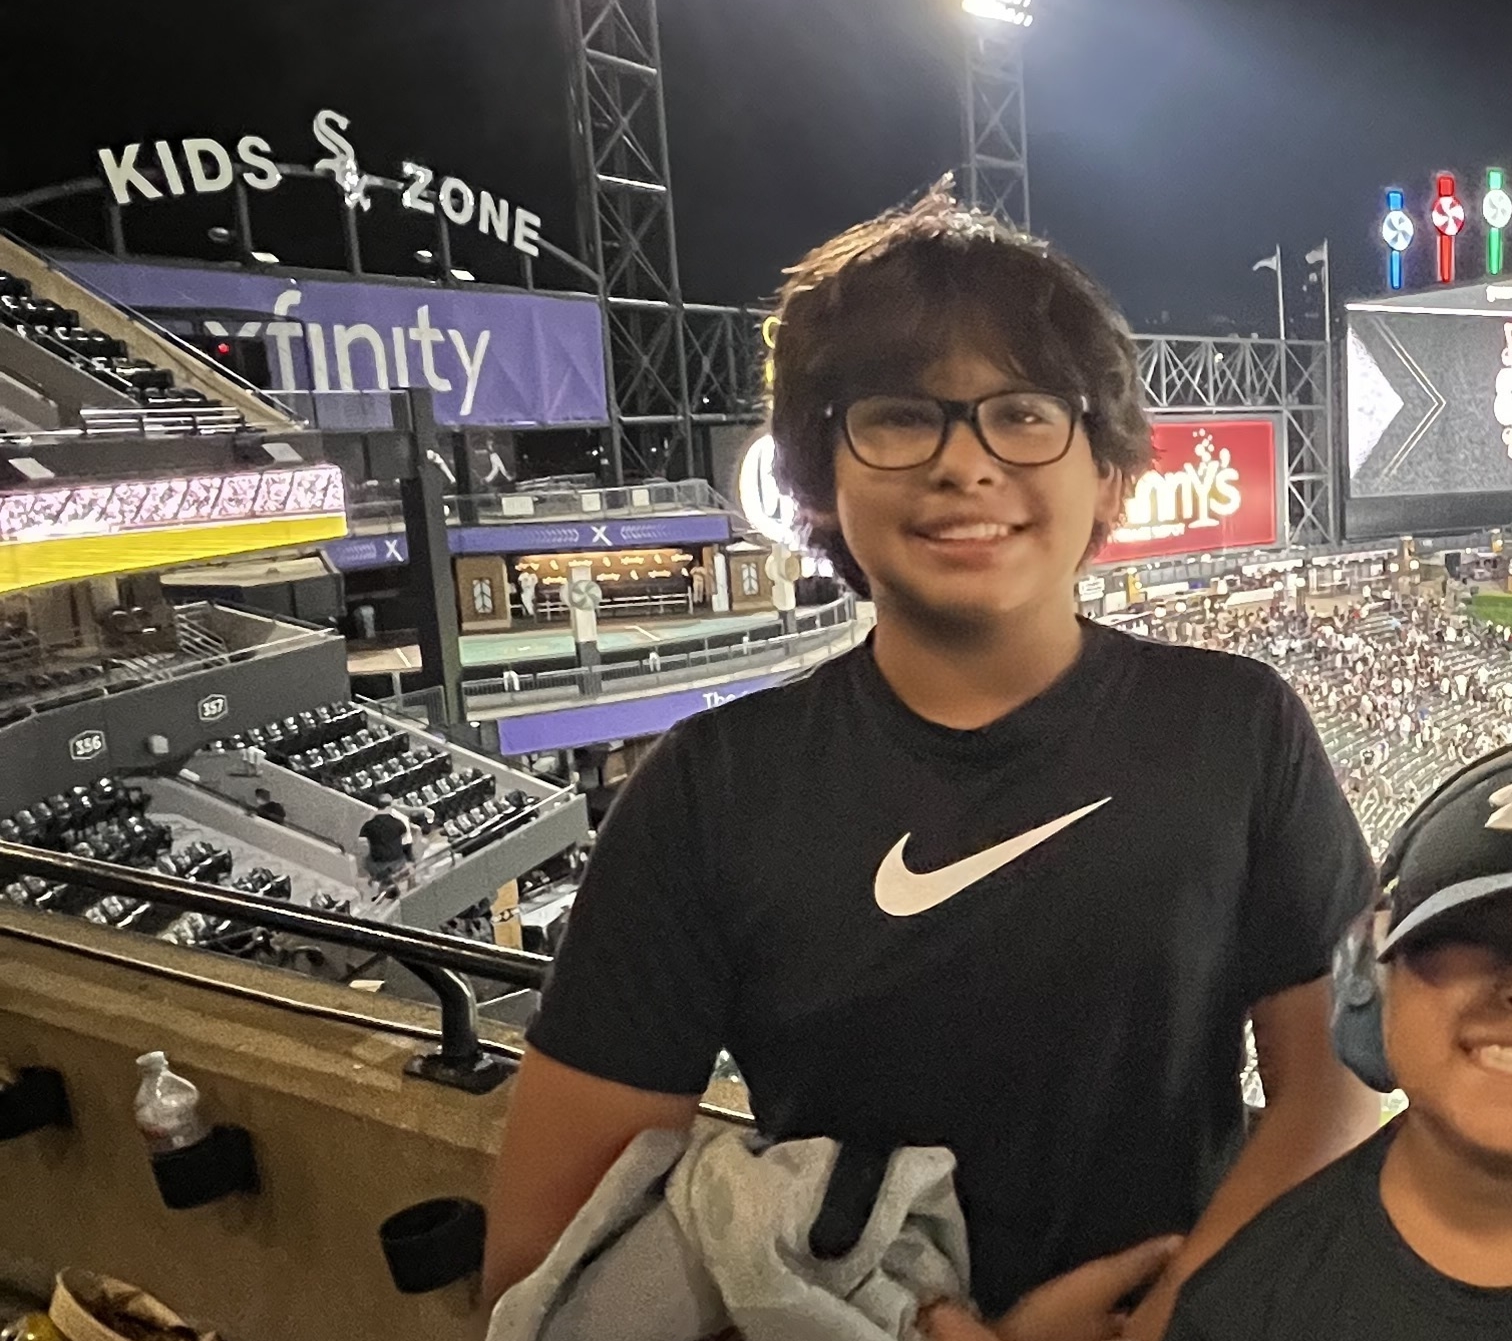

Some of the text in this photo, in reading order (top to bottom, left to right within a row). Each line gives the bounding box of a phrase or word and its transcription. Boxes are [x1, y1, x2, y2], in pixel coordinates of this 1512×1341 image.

[99, 136, 282, 204] KIDS
[403, 161, 541, 257] ZONE
[204, 289, 491, 416] finity
[203, 697, 224, 717] 357
[75, 735, 102, 756] 356
